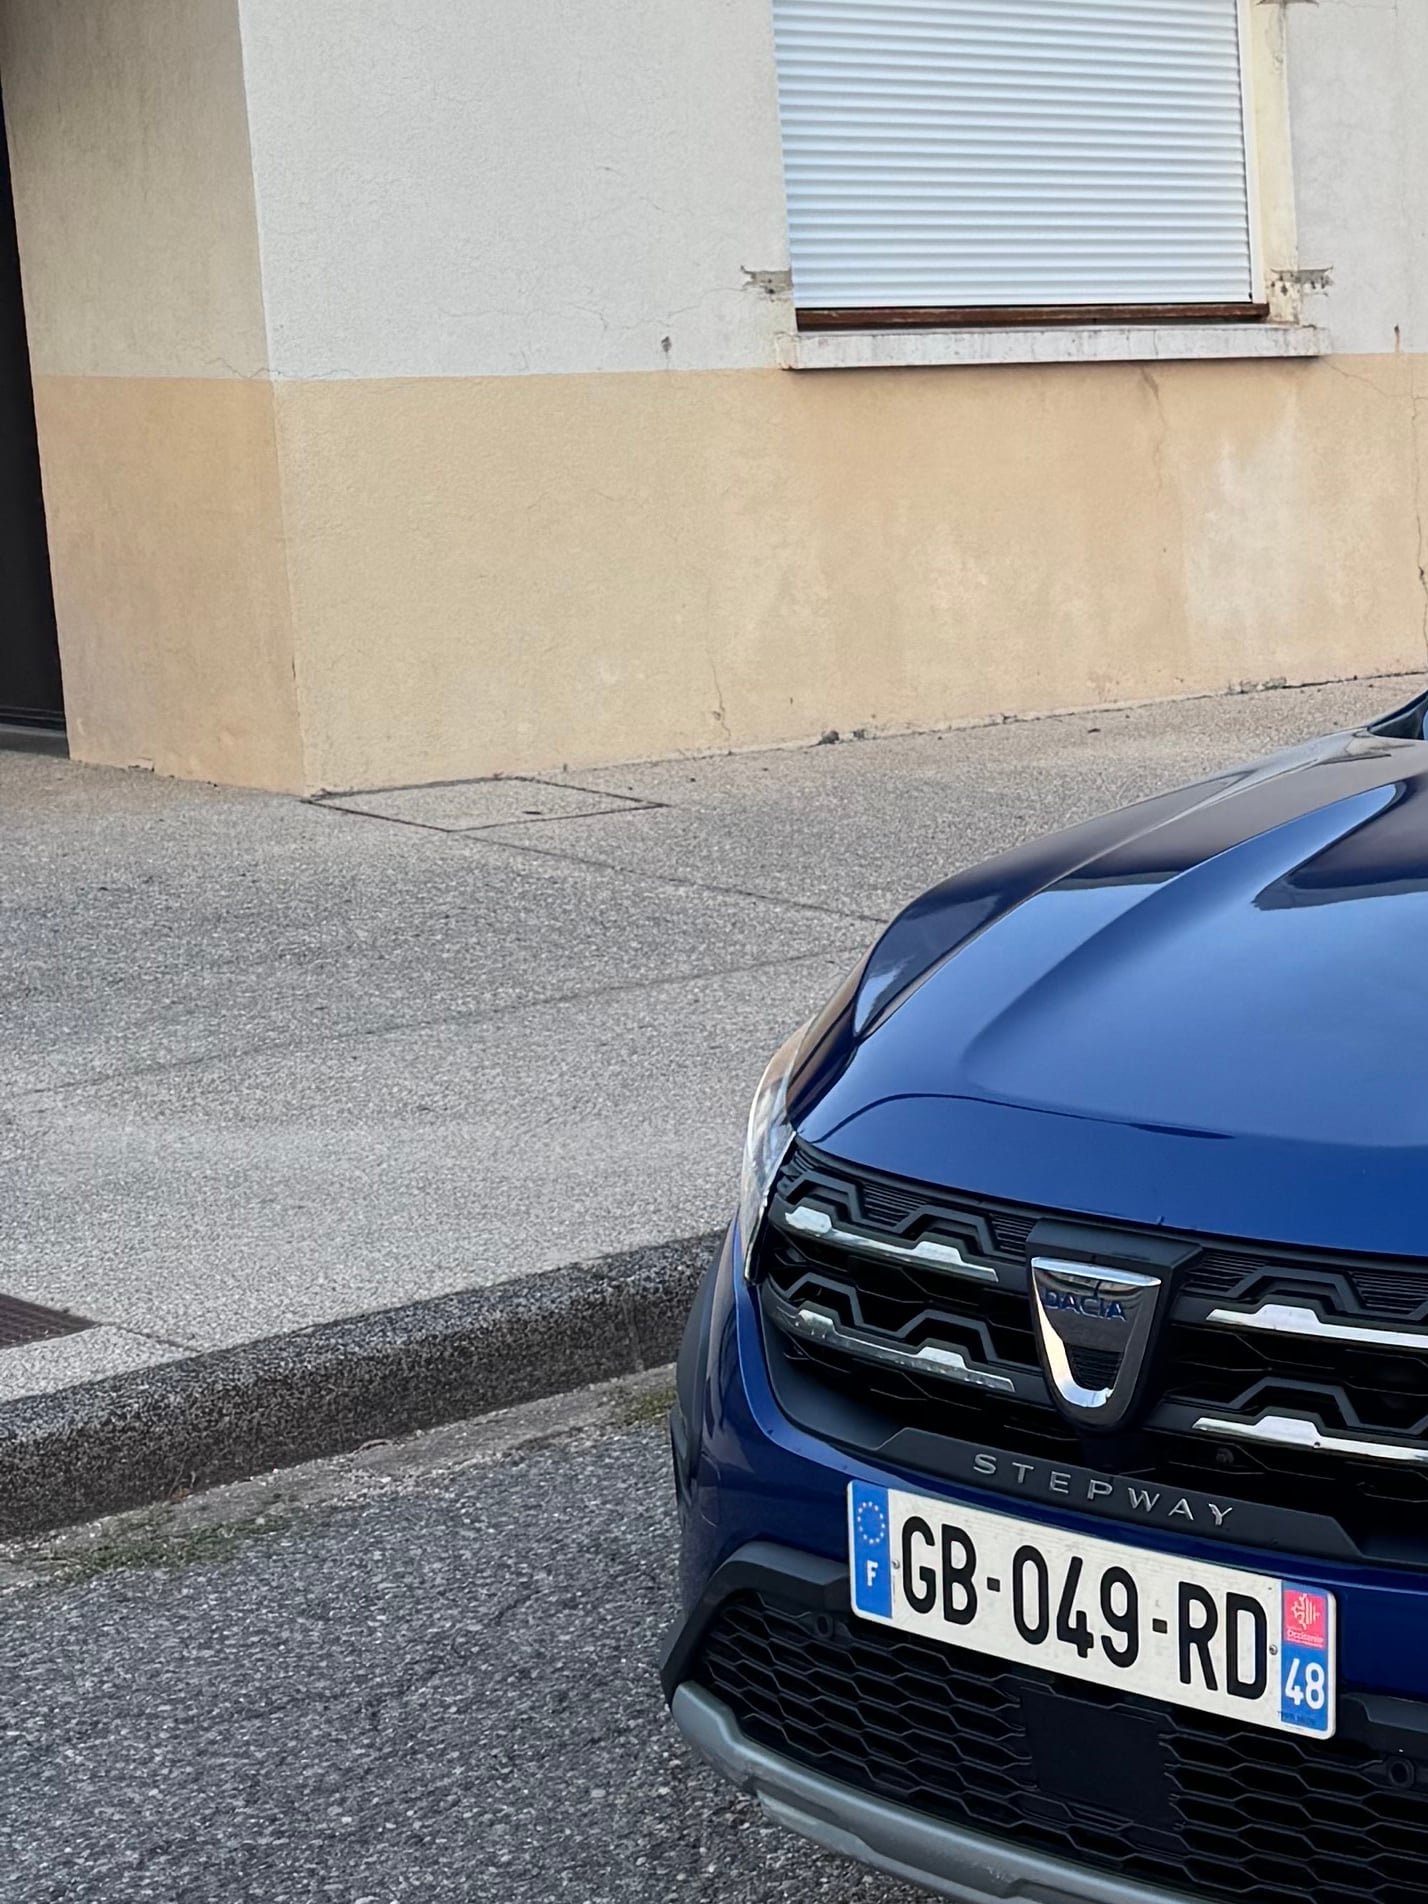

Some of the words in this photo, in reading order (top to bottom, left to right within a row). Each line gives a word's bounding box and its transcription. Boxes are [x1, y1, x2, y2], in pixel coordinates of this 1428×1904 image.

[1042, 1289, 1127, 1322] DACIA
[973, 1453, 1233, 1526] STEPWAY
[866, 1560, 878, 1587] F
[901, 1516, 1268, 1700] GB-049-RD
[1285, 1657, 1325, 1710] 48
